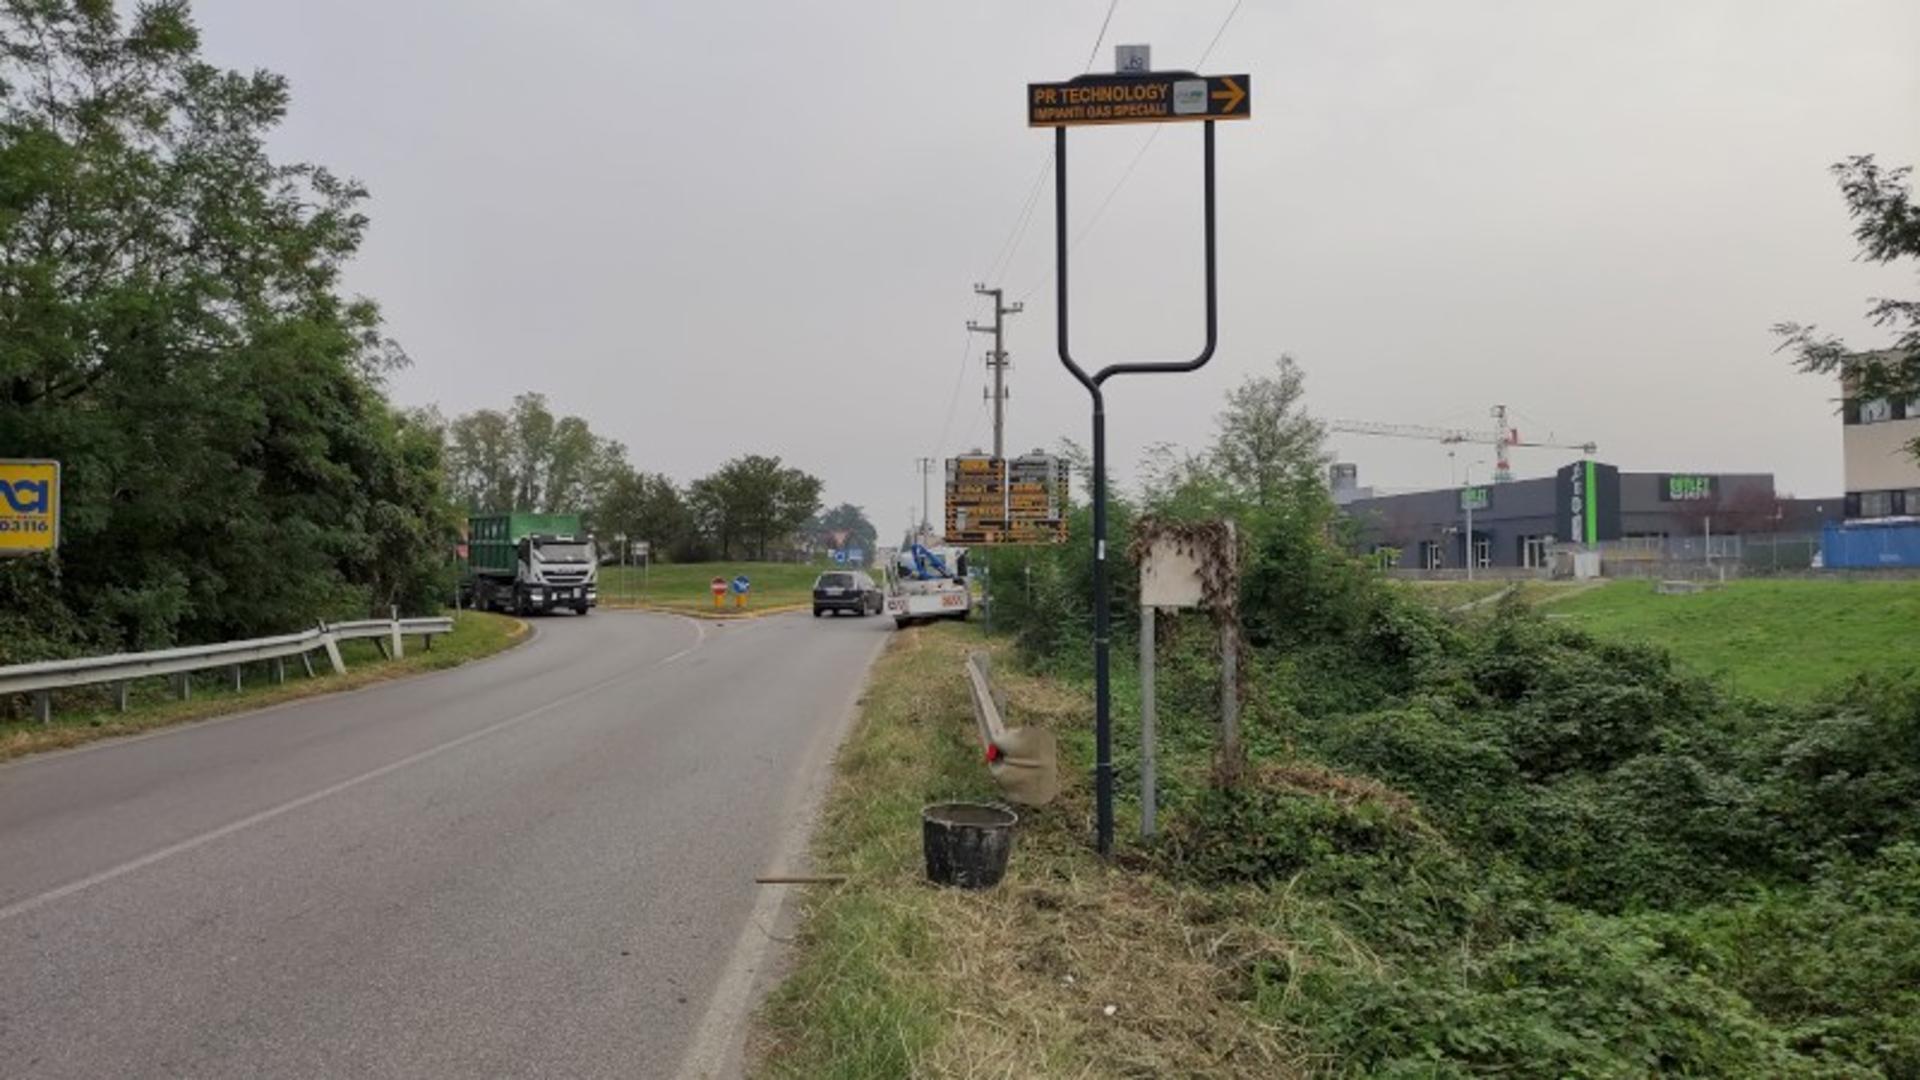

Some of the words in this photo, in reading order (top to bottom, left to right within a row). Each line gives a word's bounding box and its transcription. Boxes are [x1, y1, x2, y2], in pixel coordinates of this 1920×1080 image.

[1034, 88, 1057, 104] PR
[1059, 83, 1168, 104] TECHNOLOGY
[1086, 105, 1112, 118] GAS
[1113, 102, 1168, 117] SPECIALI
